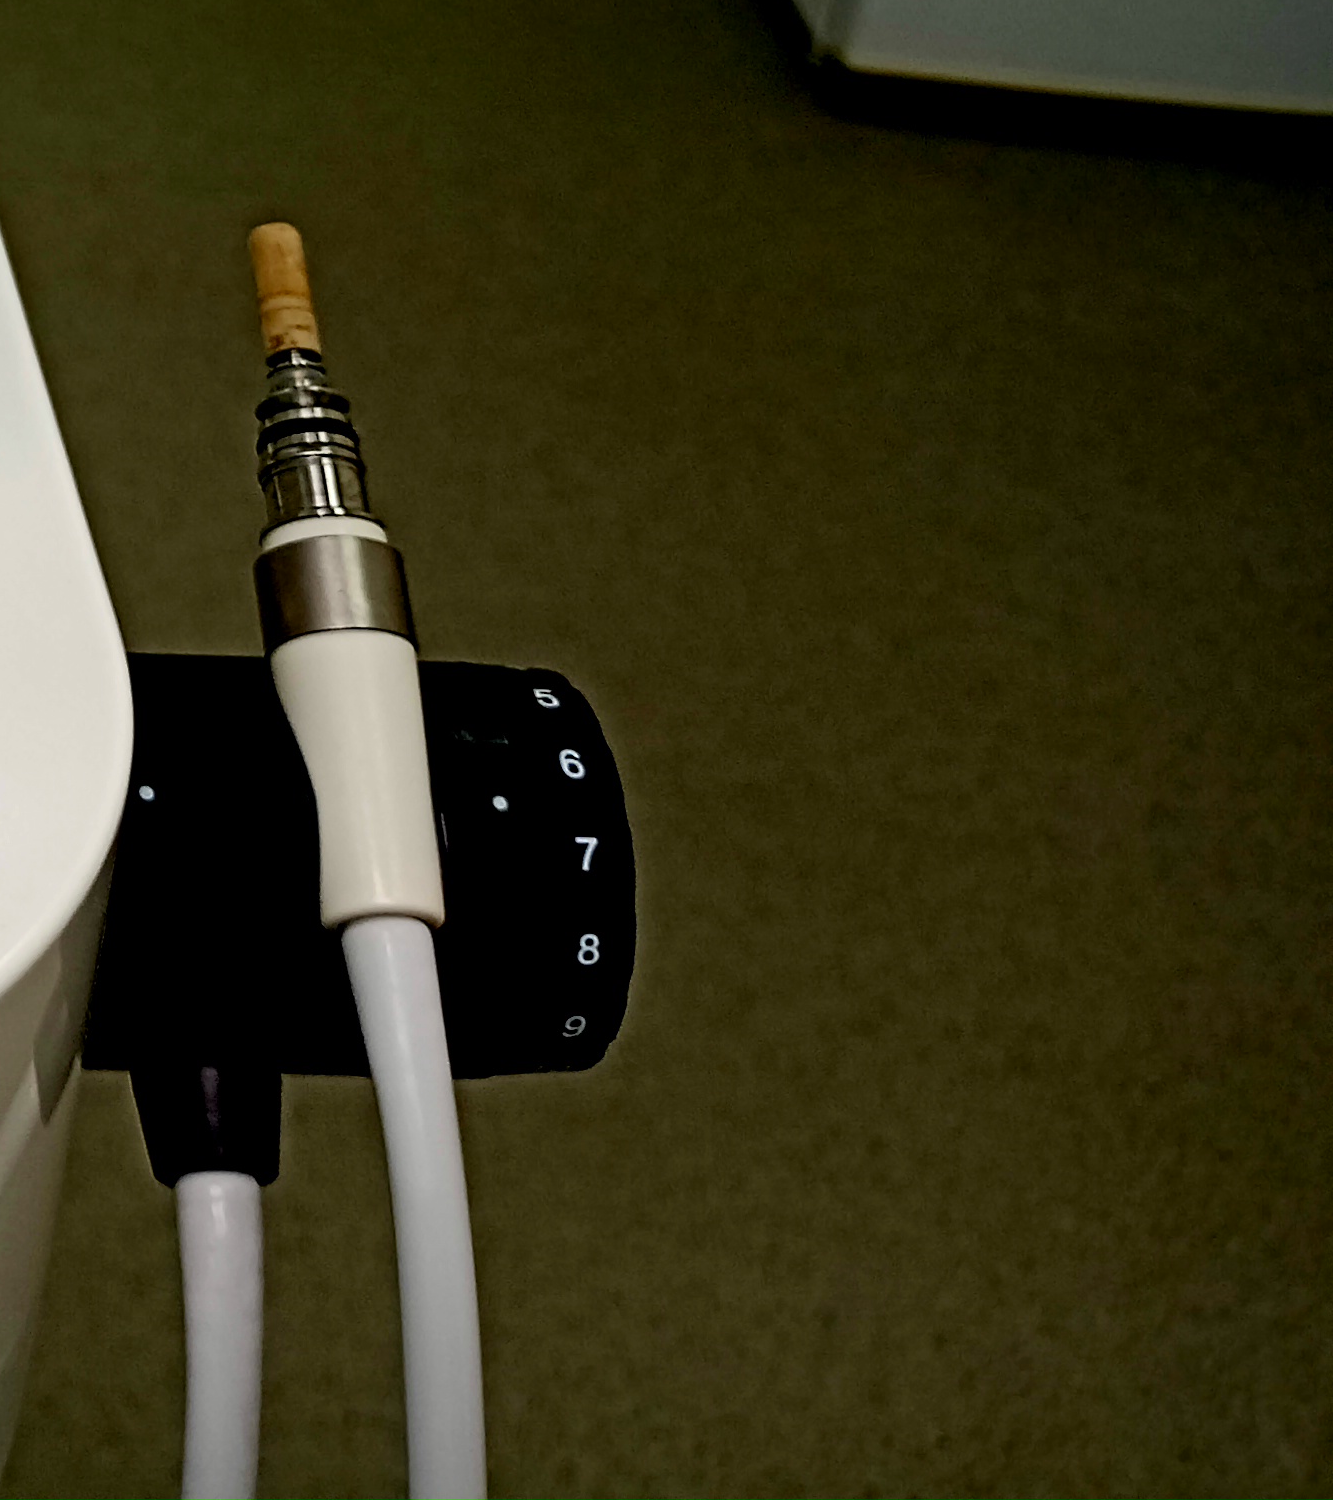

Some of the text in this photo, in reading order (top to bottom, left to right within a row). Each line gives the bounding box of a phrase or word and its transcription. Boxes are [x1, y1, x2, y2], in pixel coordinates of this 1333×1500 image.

[532, 688, 561, 709] 5
[558, 748, 586, 780] 6
[574, 836, 599, 872] 7
[577, 933, 600, 966] 8
[562, 1015, 587, 1038] 9
